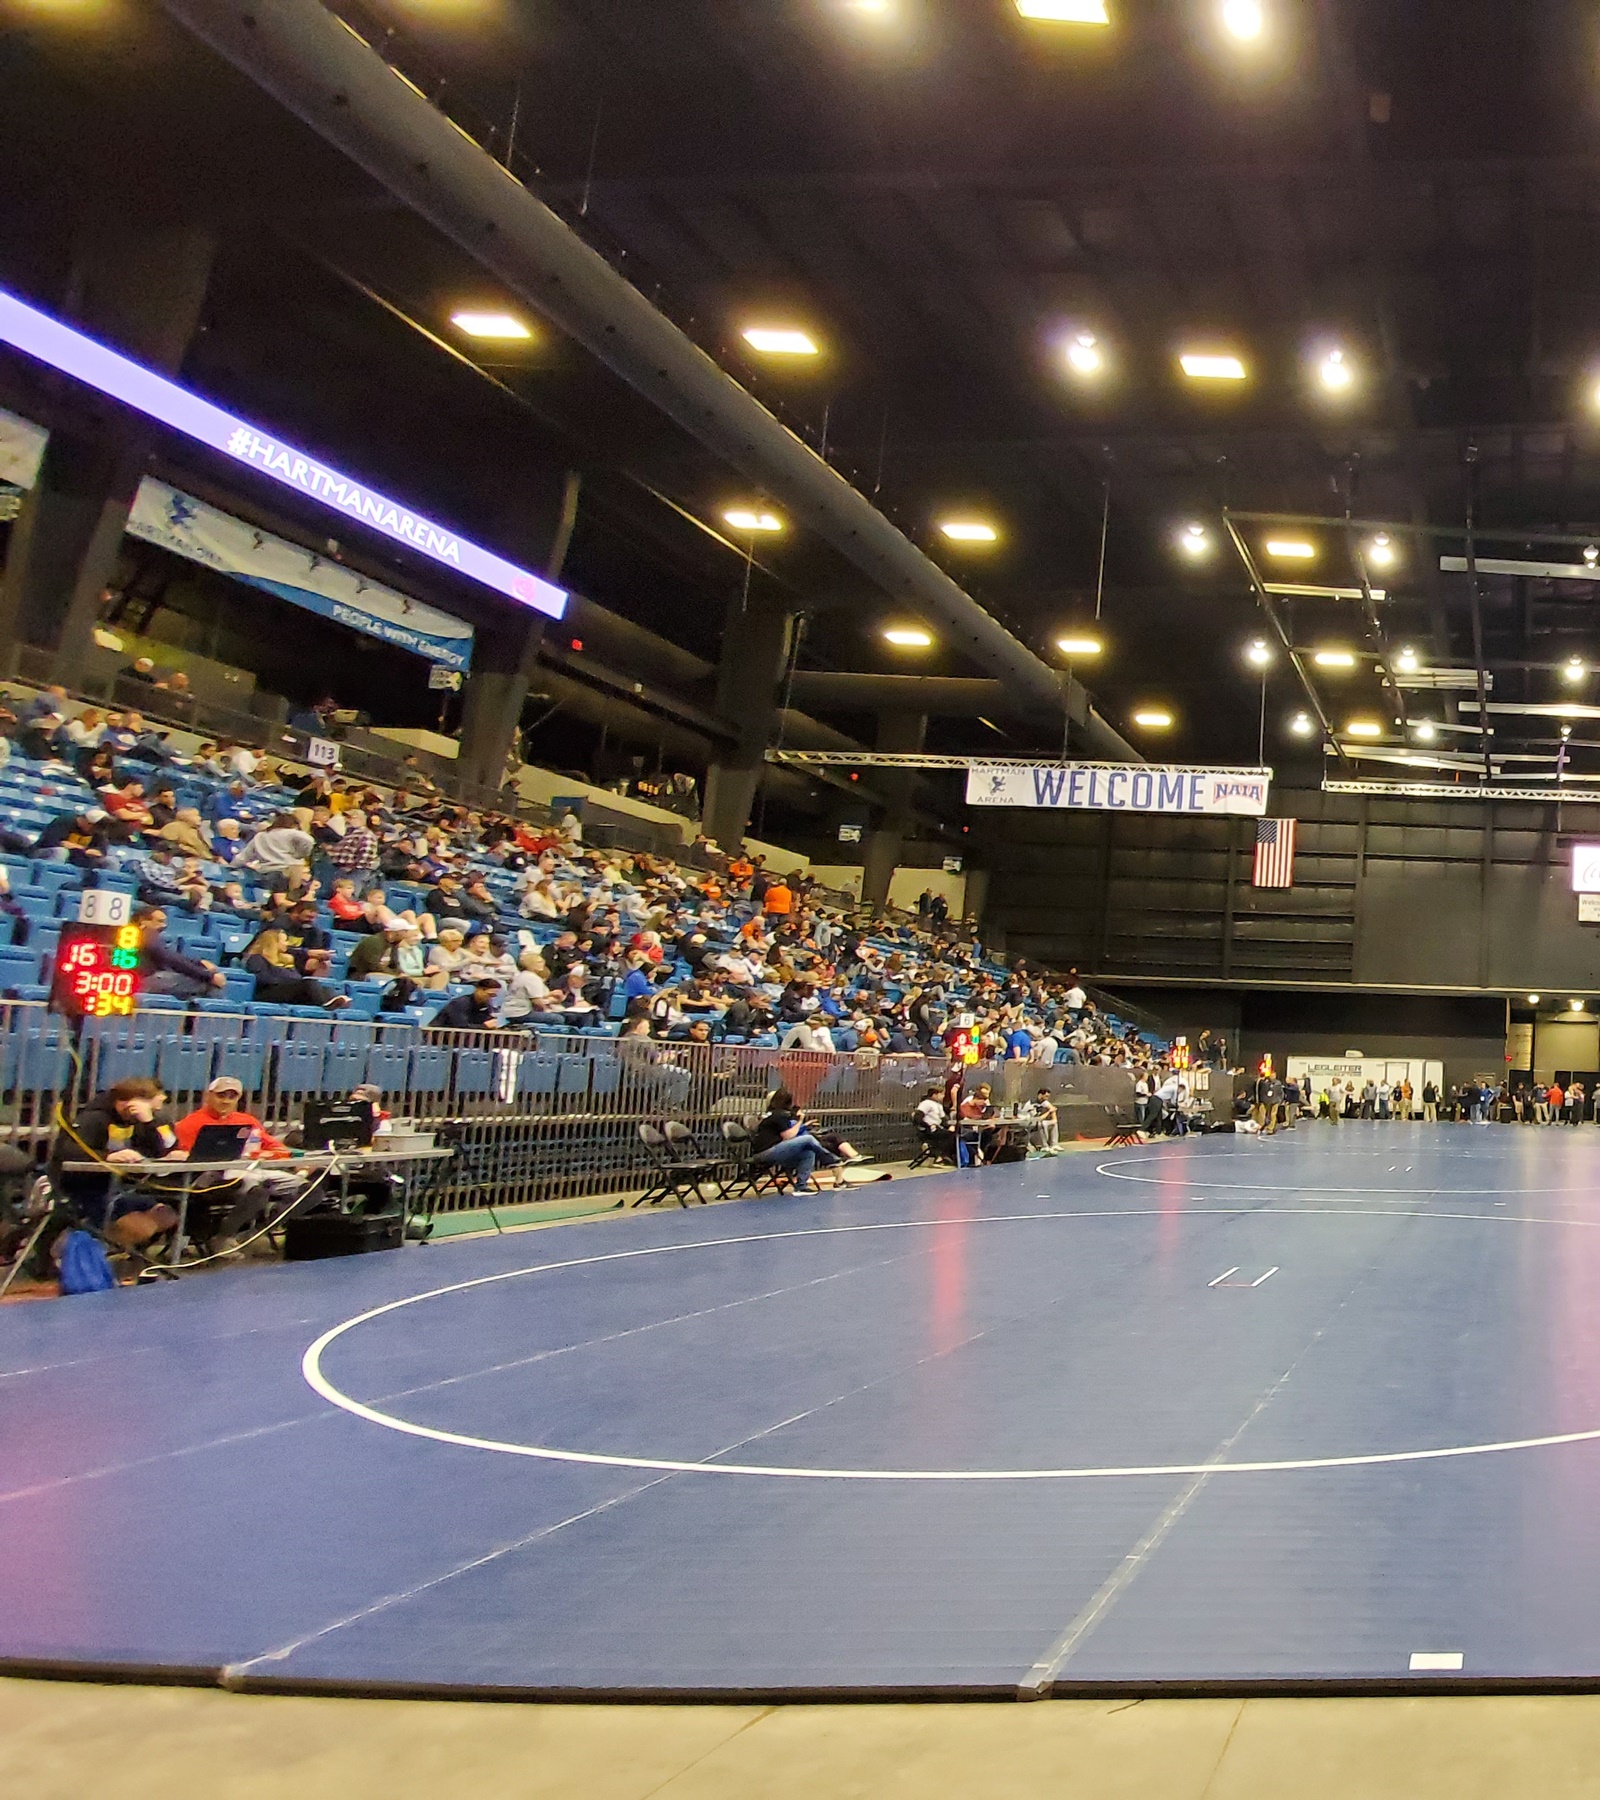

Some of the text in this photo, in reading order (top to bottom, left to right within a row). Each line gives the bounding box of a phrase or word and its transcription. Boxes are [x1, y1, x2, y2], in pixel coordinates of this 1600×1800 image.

[227, 428, 461, 563] #HARTMANARENA
[333, 604, 383, 635] PEOPLE
[314, 744, 335, 761] 113
[971, 767, 1026, 776] HARTMAN
[976, 796, 1015, 804] ARENA
[1033, 768, 1261, 811] WELCOME NAIA
[84, 894, 123, 921] 8 8
[119, 925, 139, 949] 8
[70, 943, 139, 970] 16 16
[75, 971, 132, 996] 3:00
[964, 1015, 971, 1026] 6
[1307, 1063, 1362, 1072] LEGLEITER
